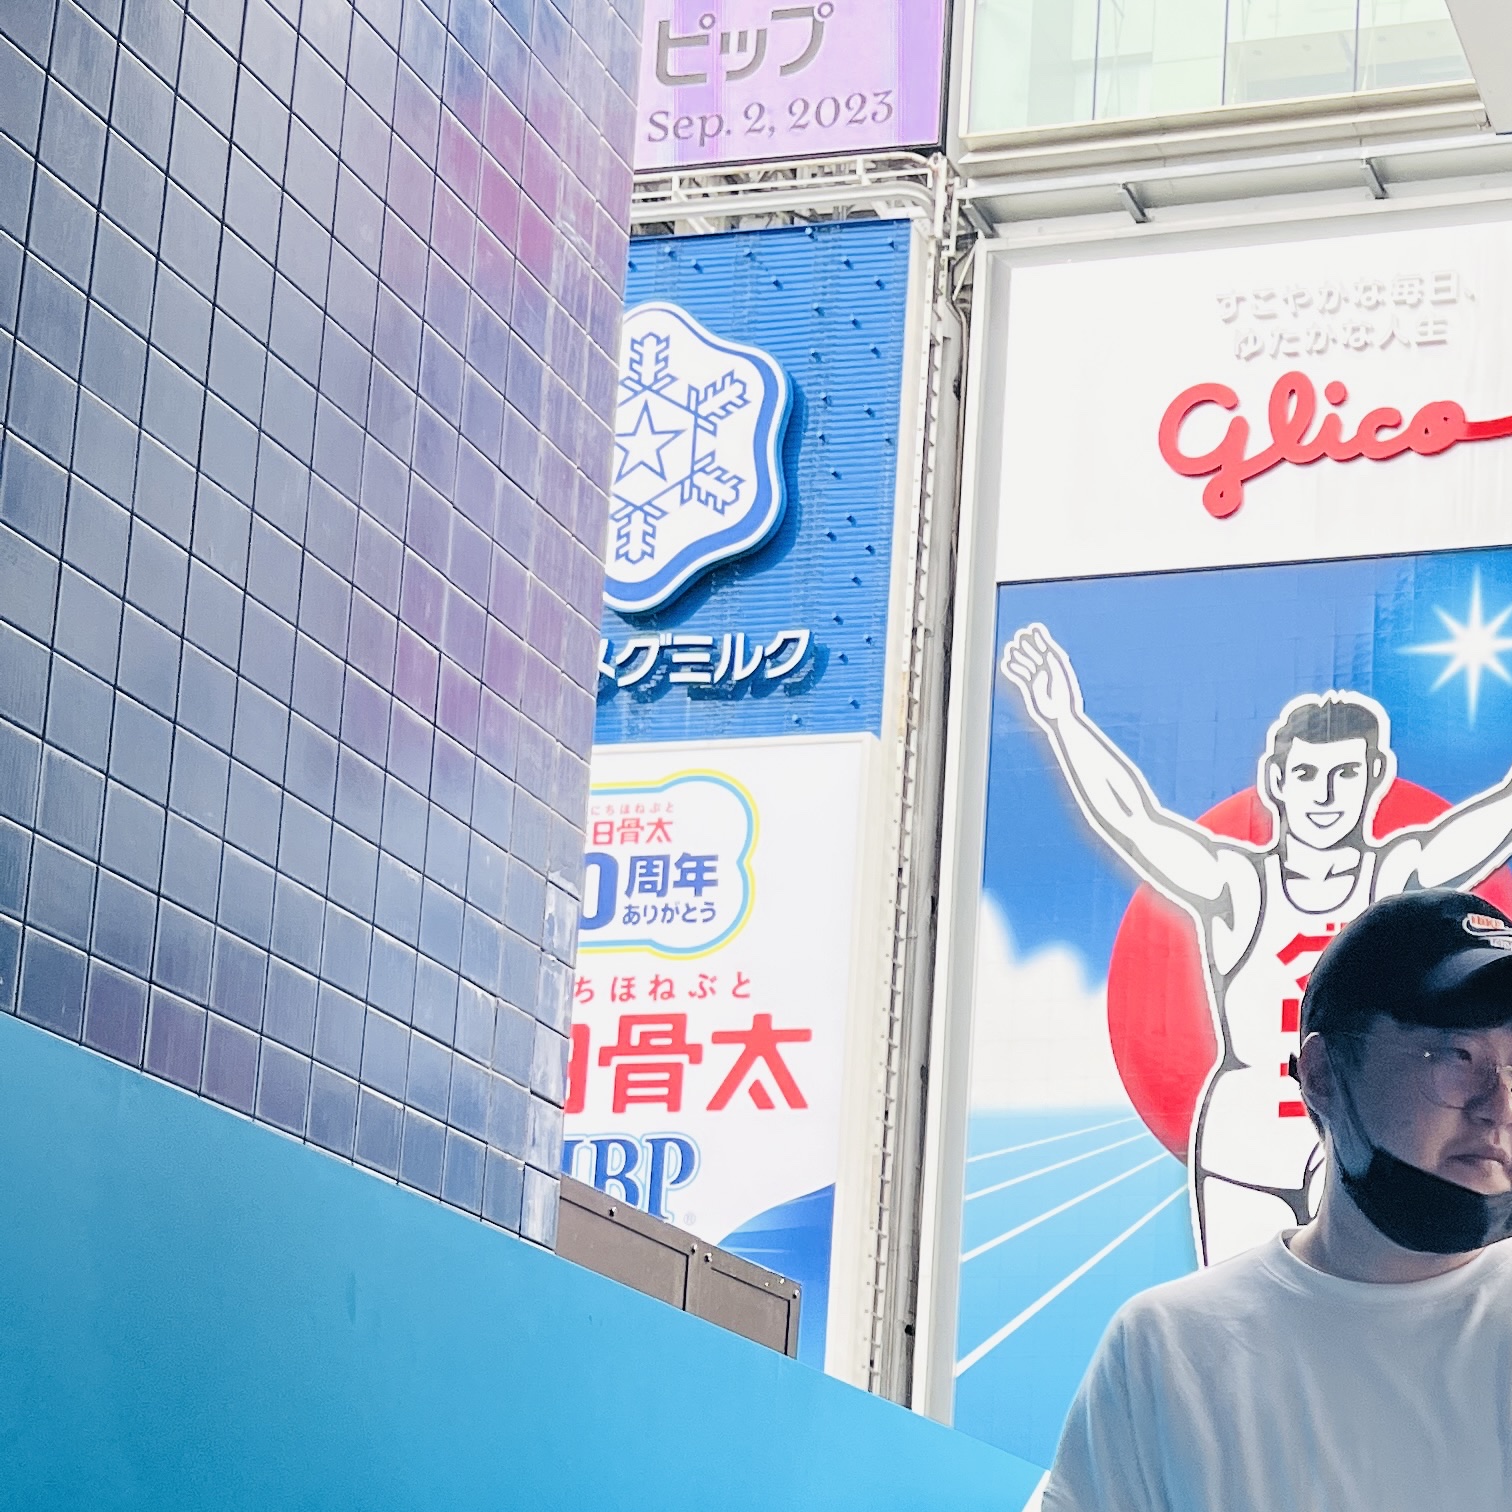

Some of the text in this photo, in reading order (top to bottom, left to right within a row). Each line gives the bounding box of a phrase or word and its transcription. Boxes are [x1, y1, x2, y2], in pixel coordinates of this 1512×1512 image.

[655, 1, 835, 87] ピップ
[647, 89, 894, 148] Sep. 2, 2023
[1235, 315, 1449, 362] ゆたかな人生
[622, 901, 716, 925] ありがとう
[574, 971, 751, 1004] ちほねぶと
